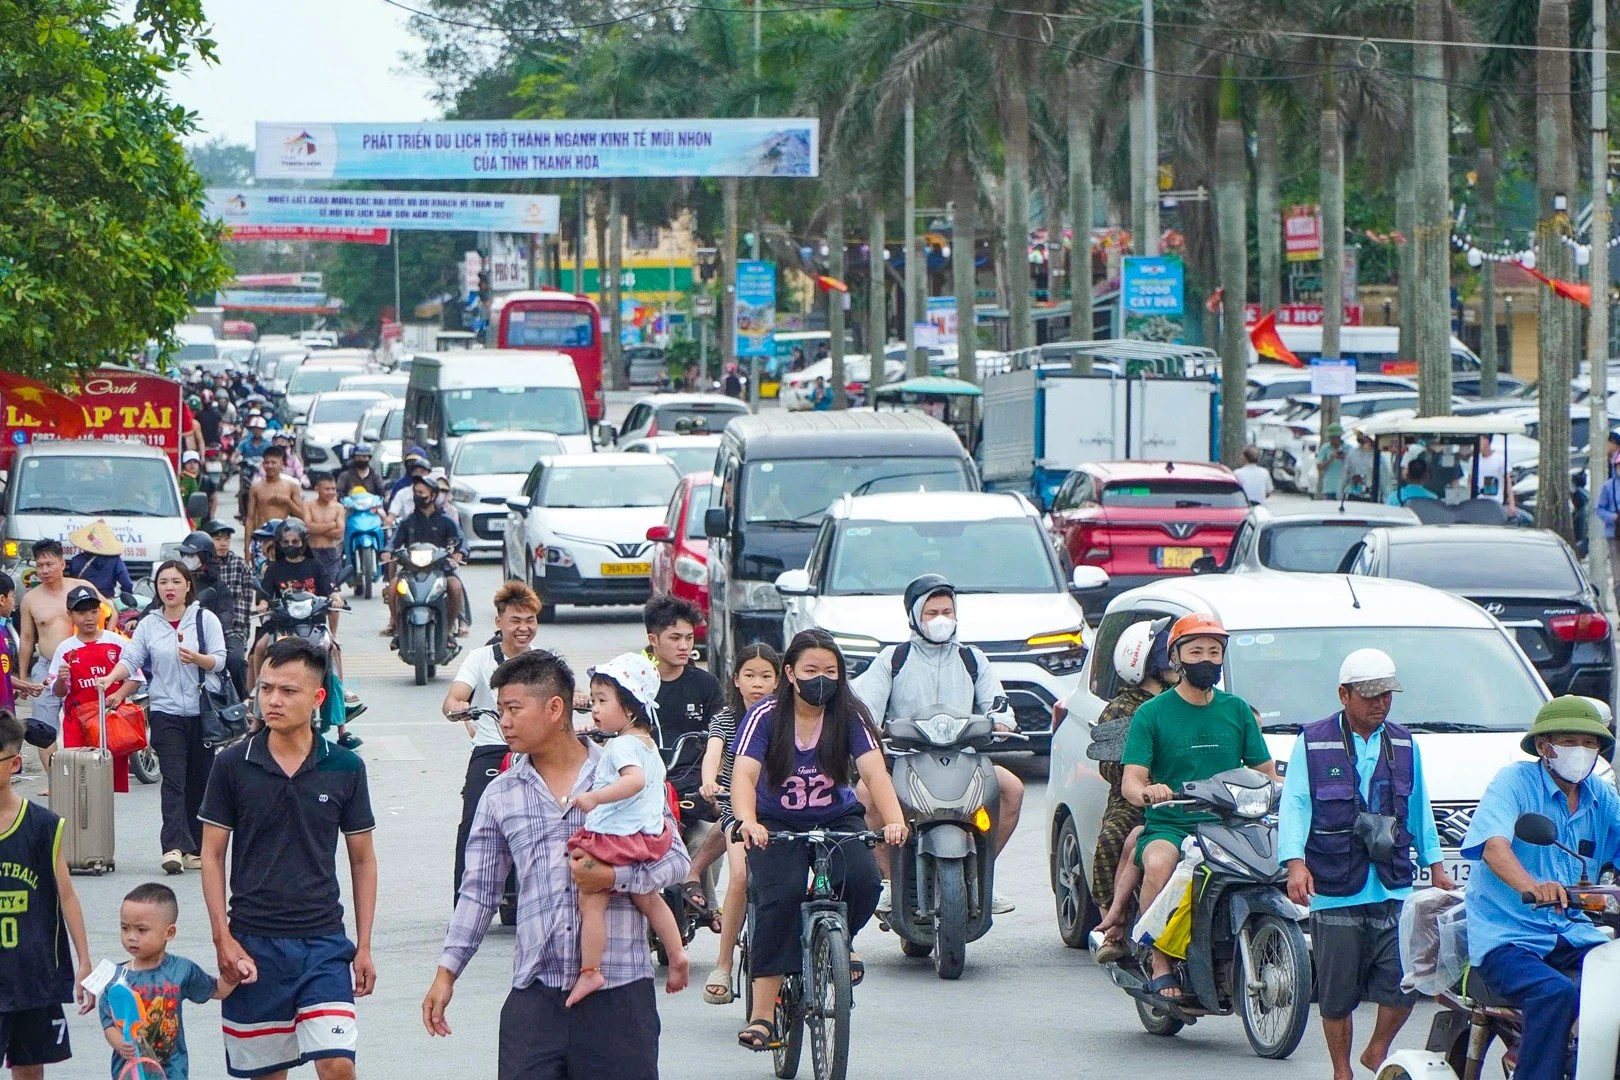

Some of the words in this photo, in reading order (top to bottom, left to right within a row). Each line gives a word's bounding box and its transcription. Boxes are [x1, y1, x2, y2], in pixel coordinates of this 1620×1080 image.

[363, 131, 393, 149] PHÁT
[398, 127, 431, 149] TRIỂN
[436, 134, 450, 149] DU
[456, 134, 481, 152] LỊCH
[486, 129, 508, 148] TRỞ
[512, 129, 550, 148] THÀNH
[555, 128, 596, 147] NGÀNH
[601, 131, 629, 147] KINH
[634, 128, 648, 147] TẾ
[651, 128, 674, 147] MŨI
[678, 131, 712, 151] NHỌN
[473, 152, 498, 172] CỦA
[502, 149, 529, 171] TỈNH
[533, 155, 572, 171] THANH
[119, 401, 172, 428] TÀI
[91, 666, 106, 675] Fly
[781, 774, 835, 810] 32
[0, 862, 38, 890] TBALL
[52, 1018, 67, 1045] 7
